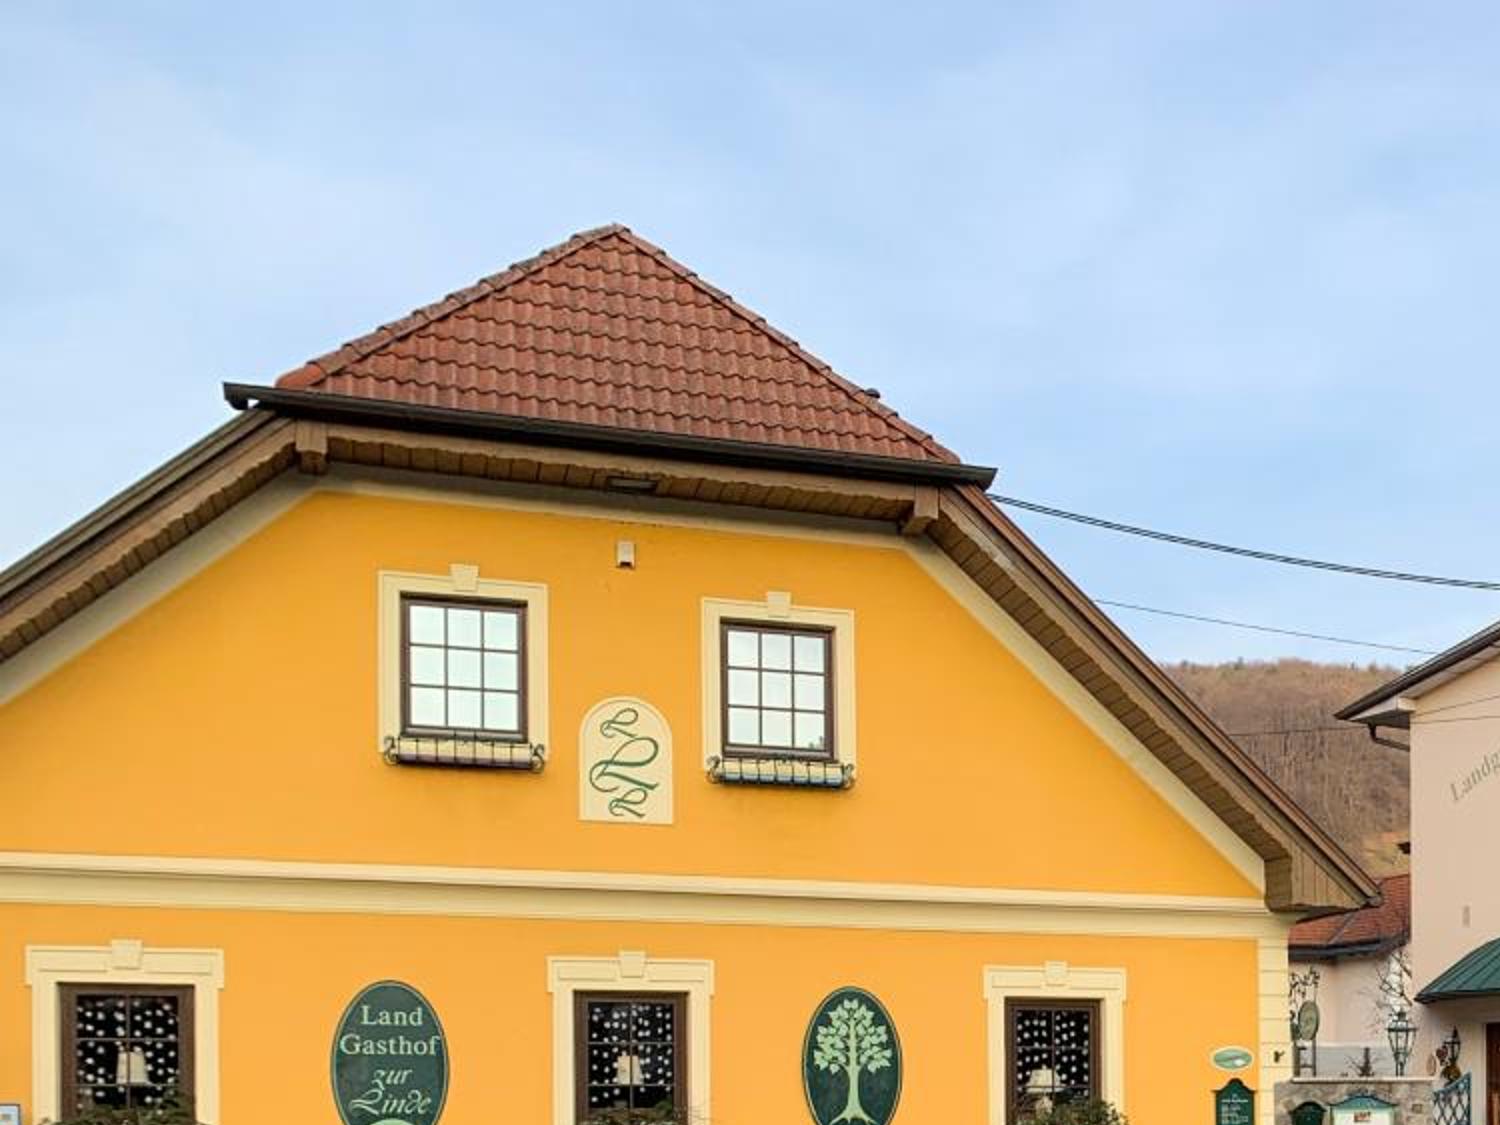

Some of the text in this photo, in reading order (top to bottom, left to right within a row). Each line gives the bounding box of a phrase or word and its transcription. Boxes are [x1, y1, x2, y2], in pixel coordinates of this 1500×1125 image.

[360, 1004, 424, 1027] Land
[338, 1032, 441, 1056] Gasthof
[370, 1068, 414, 1092] zur
[349, 1088, 432, 1116] Linde
